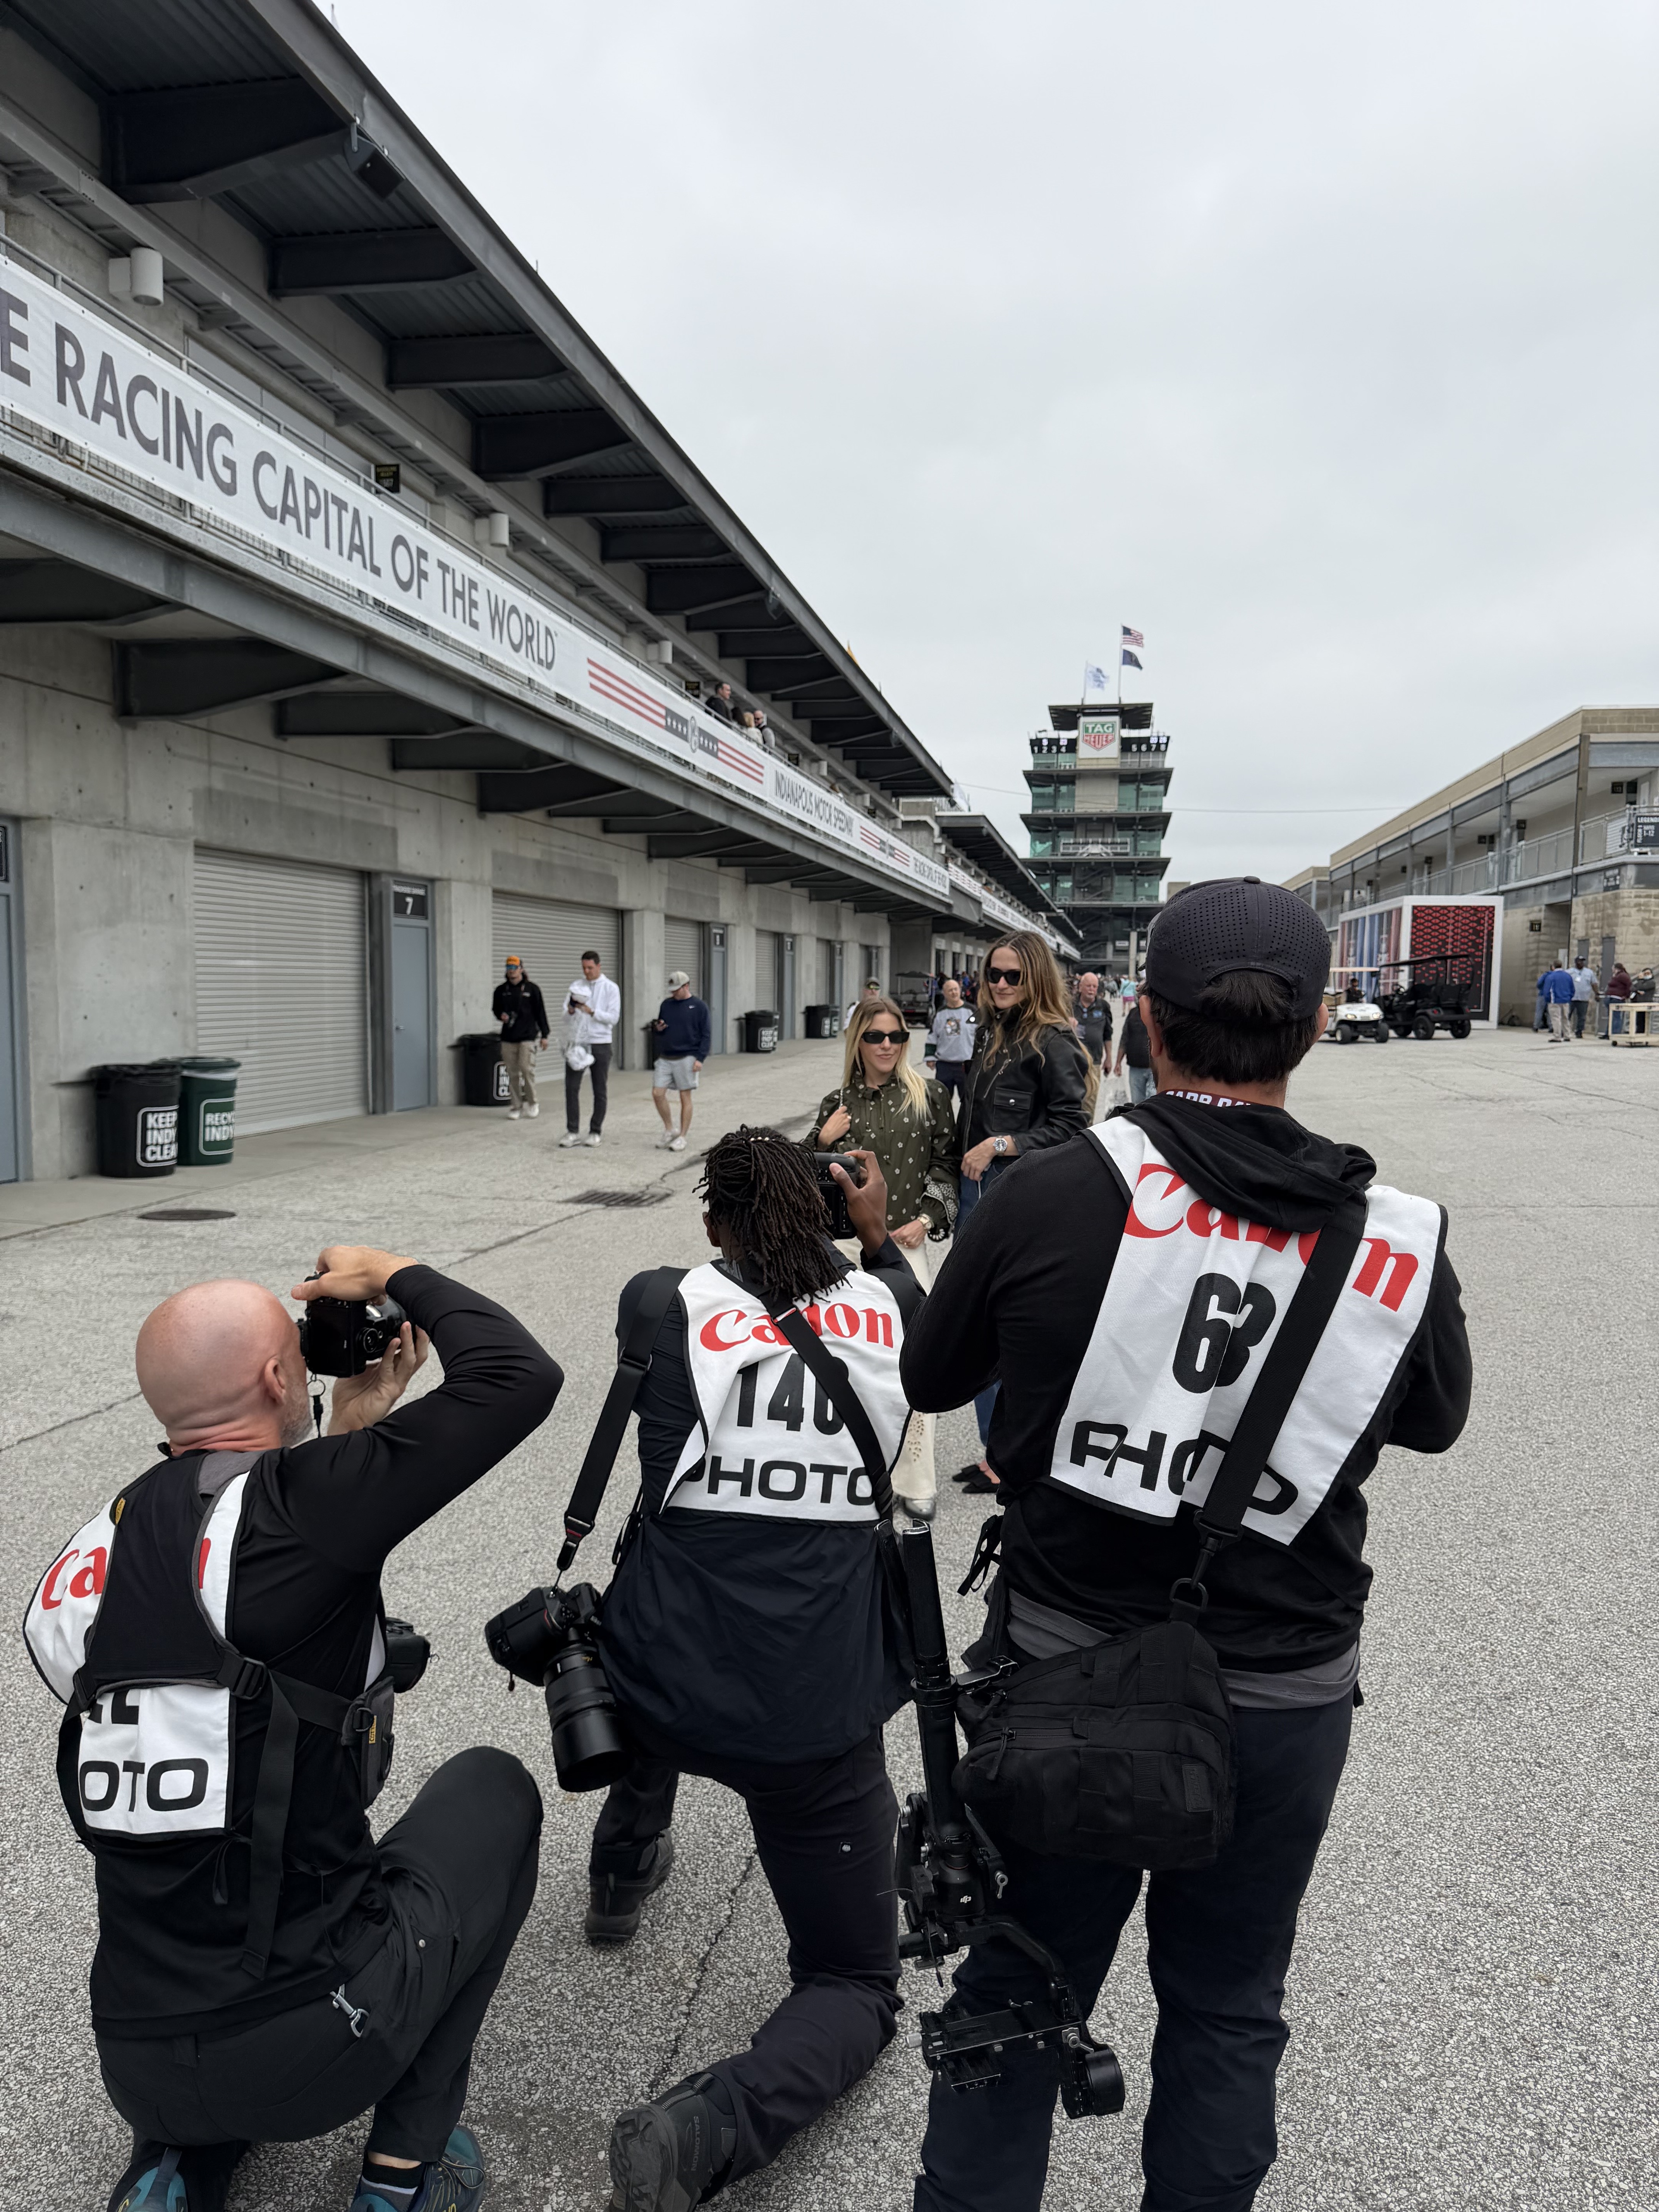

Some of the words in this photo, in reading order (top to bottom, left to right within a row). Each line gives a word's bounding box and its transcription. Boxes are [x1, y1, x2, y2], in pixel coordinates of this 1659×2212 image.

[55, 322, 238, 496] RACING
[253, 451, 381, 578] CAPITAL
[392, 534, 429, 599] OF
[438, 559, 479, 631] THE
[487, 589, 556, 670] WORLD
[1051, 745, 1057, 754] 3
[1085, 724, 1113, 733] TAG
[776, 769, 813, 816] INDIANAPOLIS
[405, 896, 413, 915] 7
[146, 1111, 178, 1128] KEEP
[1124, 1163, 1419, 1312] Can
[80, 1758, 209, 1812] OTO
[691, 2116, 700, 2171] SALOMON
